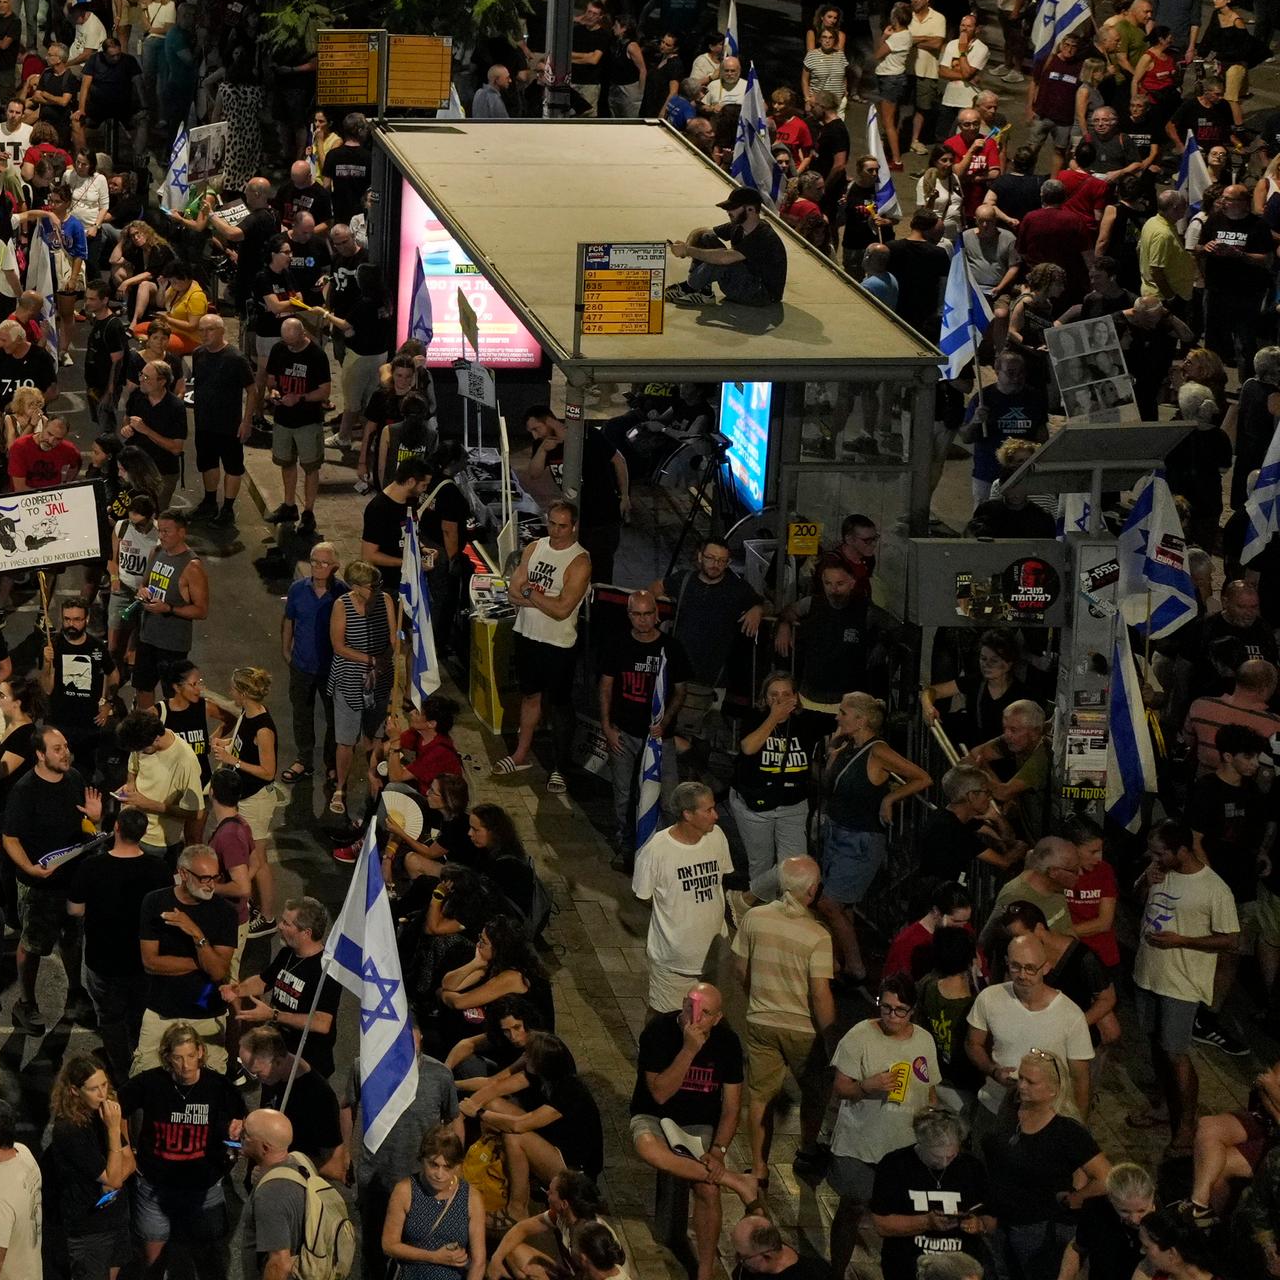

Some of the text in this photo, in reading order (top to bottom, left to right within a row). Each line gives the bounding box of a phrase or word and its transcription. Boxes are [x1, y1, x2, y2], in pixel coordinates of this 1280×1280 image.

[588, 271, 597, 279] 91
[586, 292, 601, 300] 177
[585, 303, 603, 311] 280
[585, 313, 603, 321] 477
[26, 506, 41, 519] TO
[43, 500, 71, 517] JAIL
[793, 524, 818, 537] 200
[1018, 586, 1044, 595] מוביל
[1011, 593, 1052, 603] למלחמת
[676, 866, 693, 881] את
[153, 1121, 210, 1154] עכשיו
[908, 1190, 962, 1215] די
